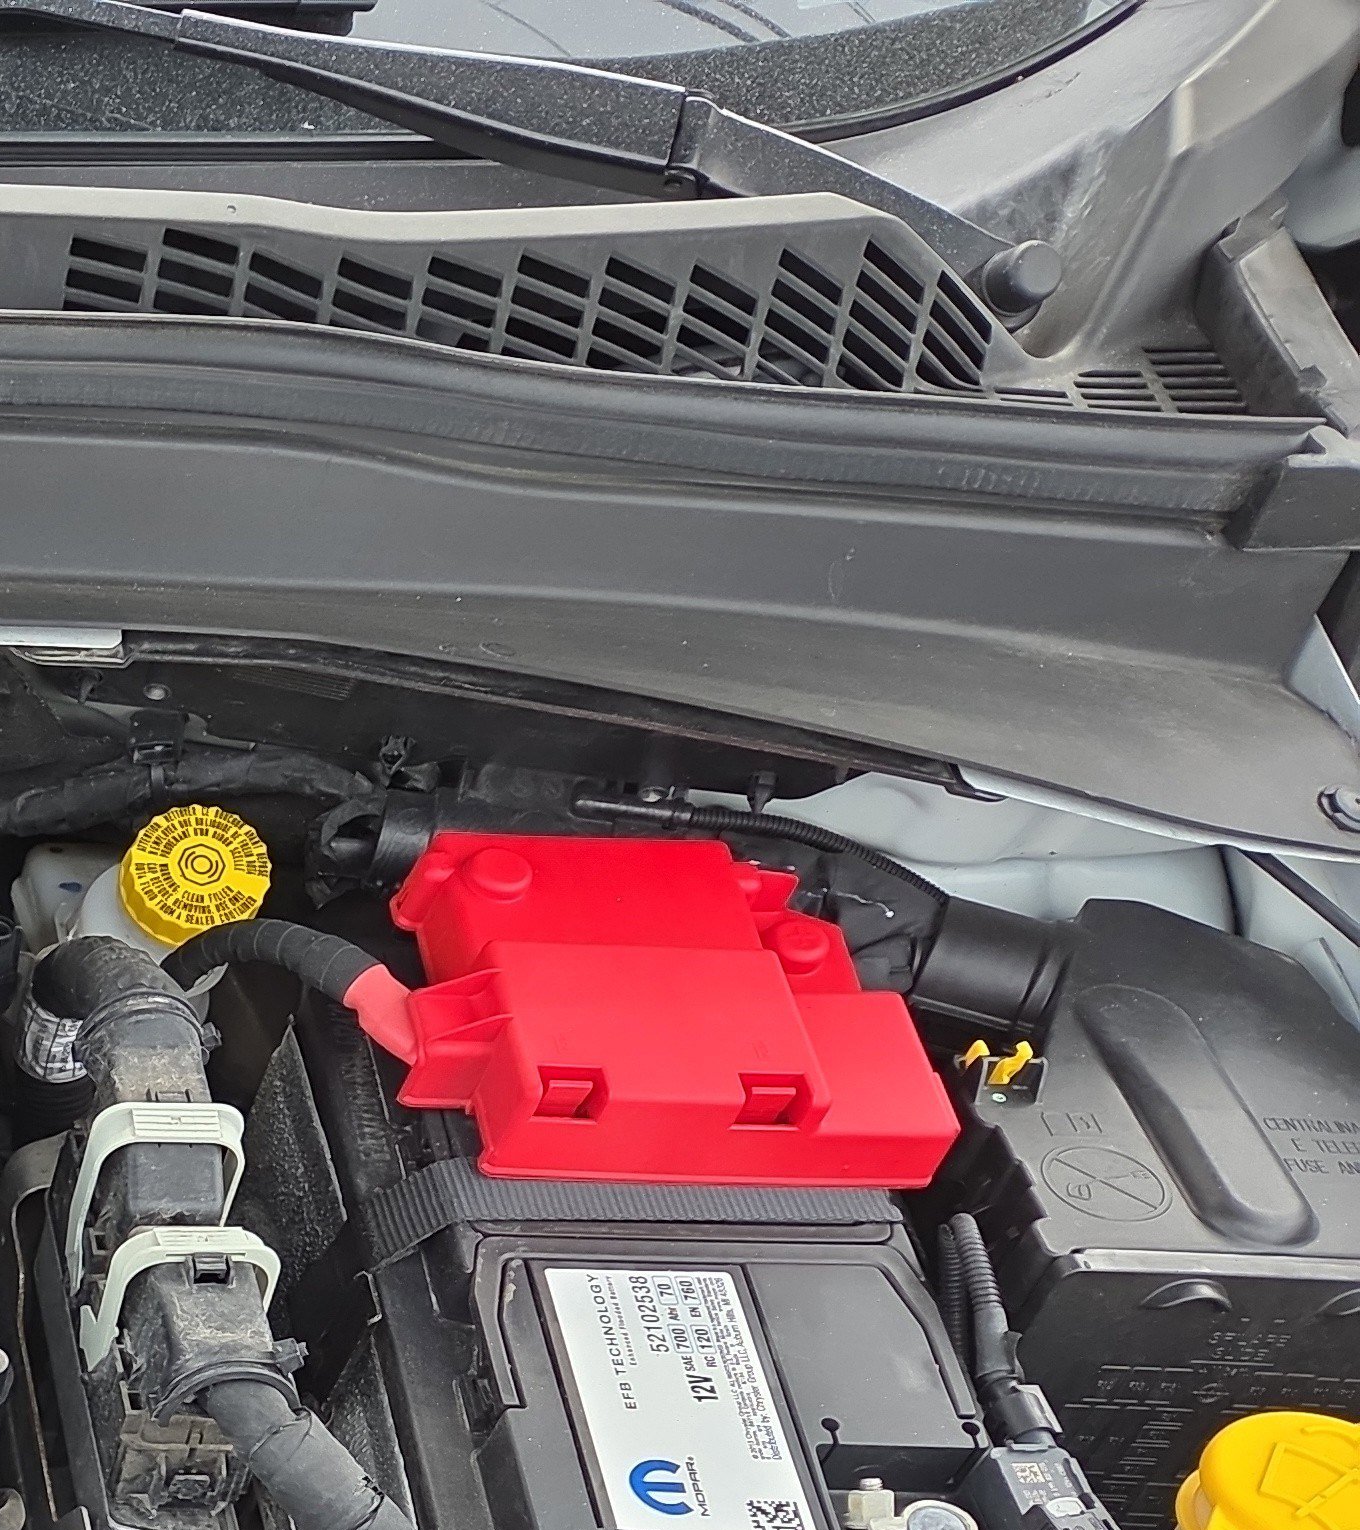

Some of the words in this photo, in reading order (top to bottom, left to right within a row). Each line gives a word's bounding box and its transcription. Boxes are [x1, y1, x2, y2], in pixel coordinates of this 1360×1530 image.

[140, 881, 158, 901] FLUID
[155, 900, 176, 917] FROM
[185, 913, 216, 926] SEALED
[219, 896, 258, 923] CONTAINER
[150, 876, 174, 901] BEFORE
[215, 901, 230, 912] USE
[182, 890, 205, 904] CLEAN
[1291, 1138, 1307, 1152] E
[1283, 1158, 1329, 1174] FUSE
[606, 1276, 617, 1299] Battery
[657, 1284, 673, 1297] 70
[679, 1281, 697, 1300] 760
[612, 1303, 626, 1329] Flooded
[629, 1276, 669, 1352] 52102538
[688, 1307, 702, 1317] EN
[587, 1274, 626, 1375] TECHNOLOGY
[620, 1333, 637, 1365] Enhanced
[671, 1328, 690, 1349] 700
[695, 1329, 713, 1349] 120
[681, 1356, 696, 1371] SAE
[704, 1356, 717, 1367] RC
[619, 1383, 637, 1409] EFB
[686, 1374, 718, 1402] 12V
